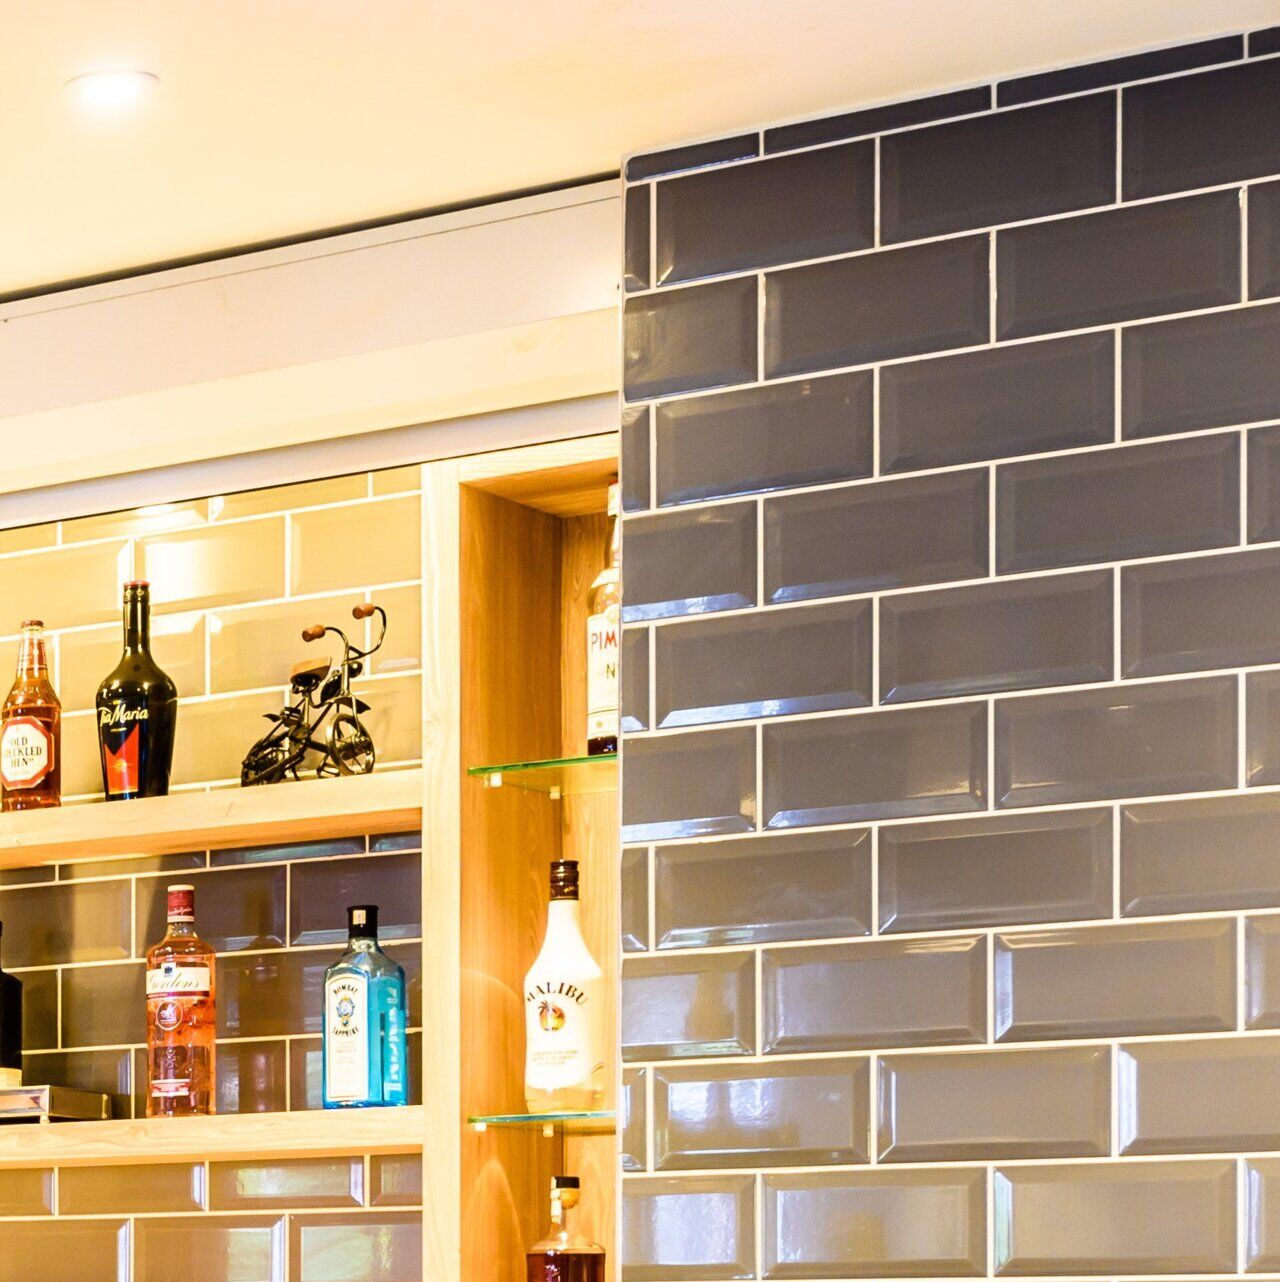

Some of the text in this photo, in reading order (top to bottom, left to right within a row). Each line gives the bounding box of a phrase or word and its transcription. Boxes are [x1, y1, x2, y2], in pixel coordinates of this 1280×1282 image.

[591, 631, 617, 651] PIM
[98, 705, 148, 727] Tia Maria
[527, 982, 588, 1006] MALIBU
